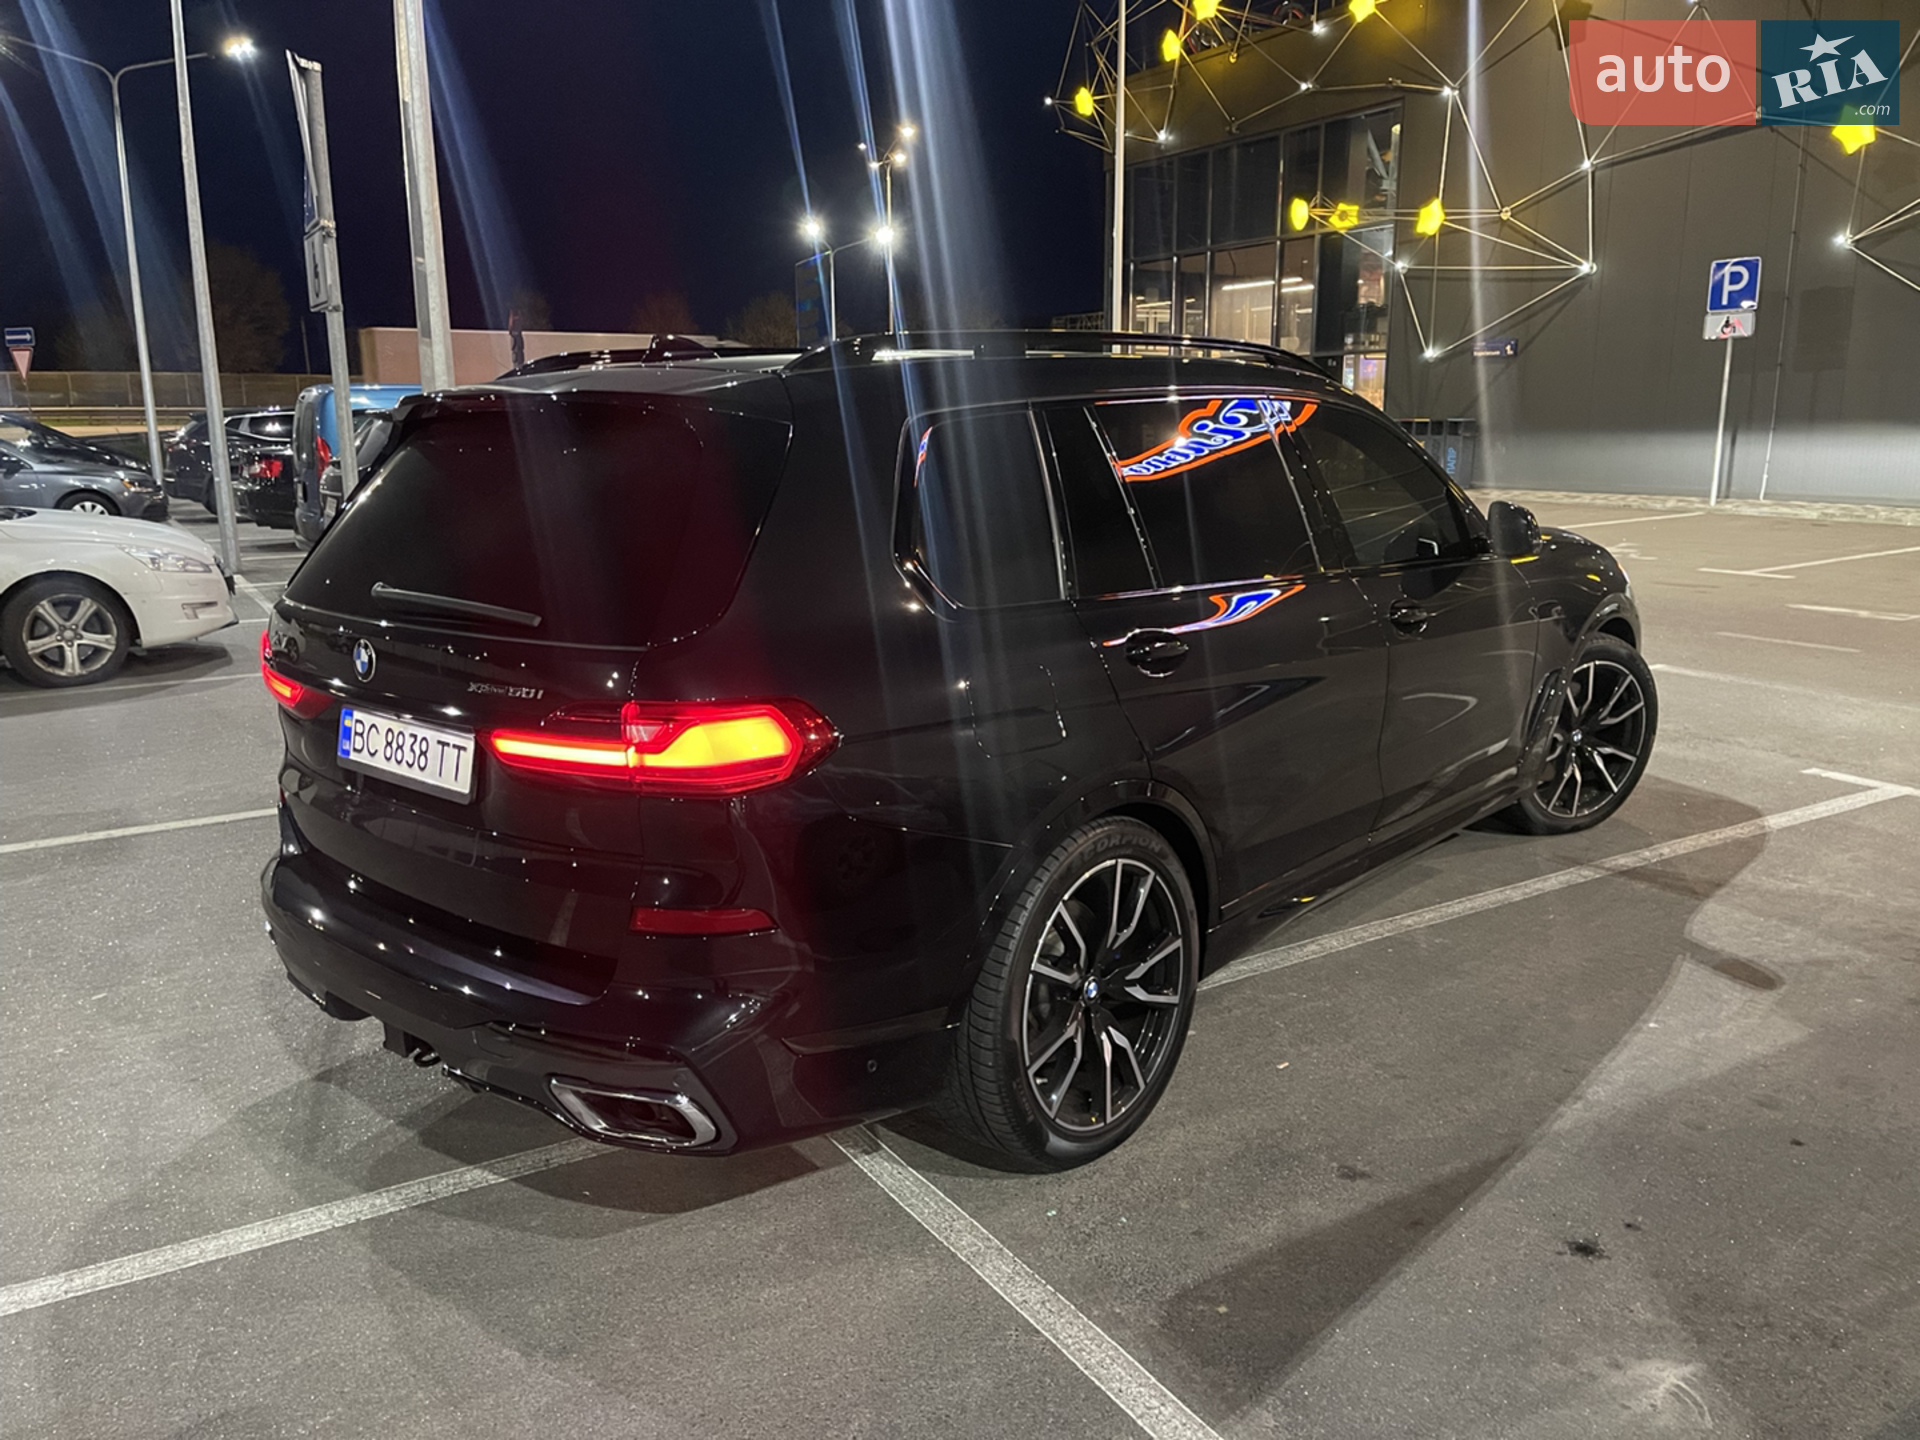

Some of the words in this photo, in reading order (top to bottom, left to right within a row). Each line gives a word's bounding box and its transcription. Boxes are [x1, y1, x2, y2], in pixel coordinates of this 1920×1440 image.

[1721, 265, 1749, 306] P
[352, 718, 380, 758] BC
[383, 727, 430, 772] 8838
[436, 739, 468, 783] TT
